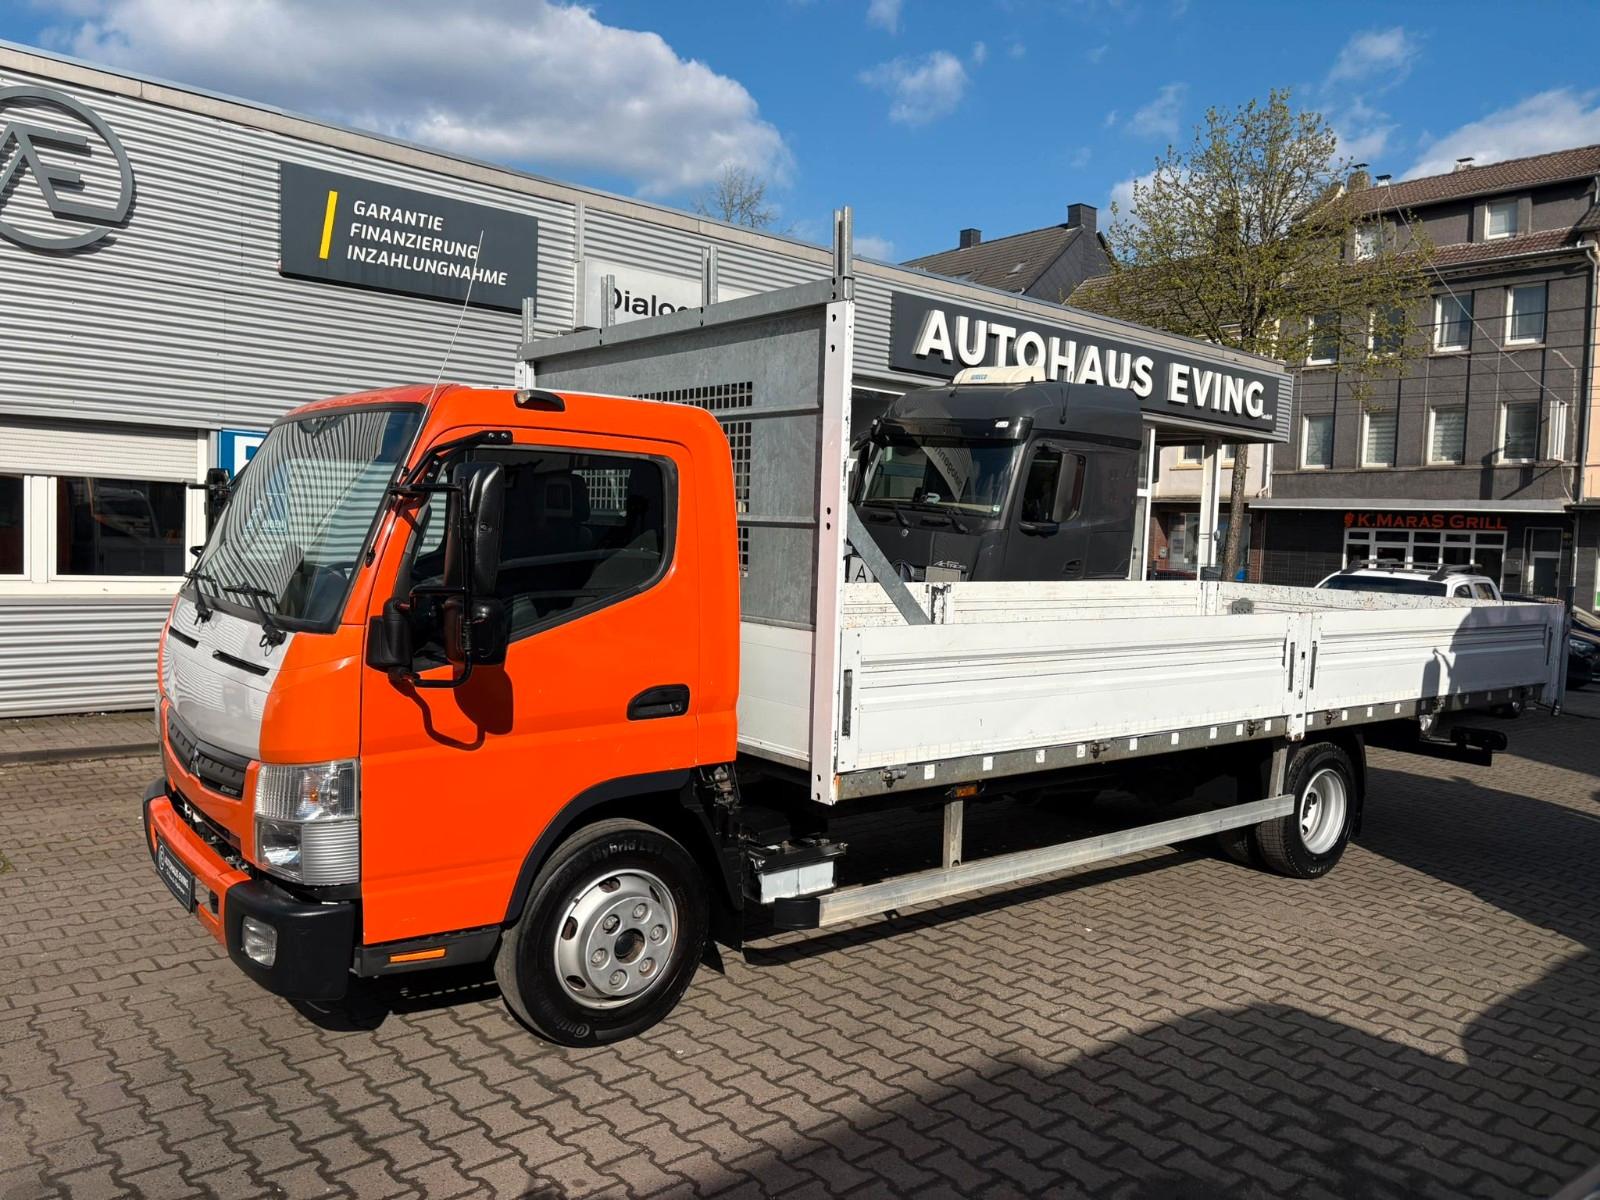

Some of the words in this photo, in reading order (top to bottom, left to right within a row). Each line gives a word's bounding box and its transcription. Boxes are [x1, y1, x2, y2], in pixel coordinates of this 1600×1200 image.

[353, 200, 444, 231] GARANTIE
[350, 223, 478, 260] FINANZIERUNG
[347, 245, 508, 286] INZAHLUNGNAHME
[914, 309, 1154, 398] AUTOHAUS
[1168, 362, 1265, 418] EVING
[1450, 513, 1508, 530] GRILL
